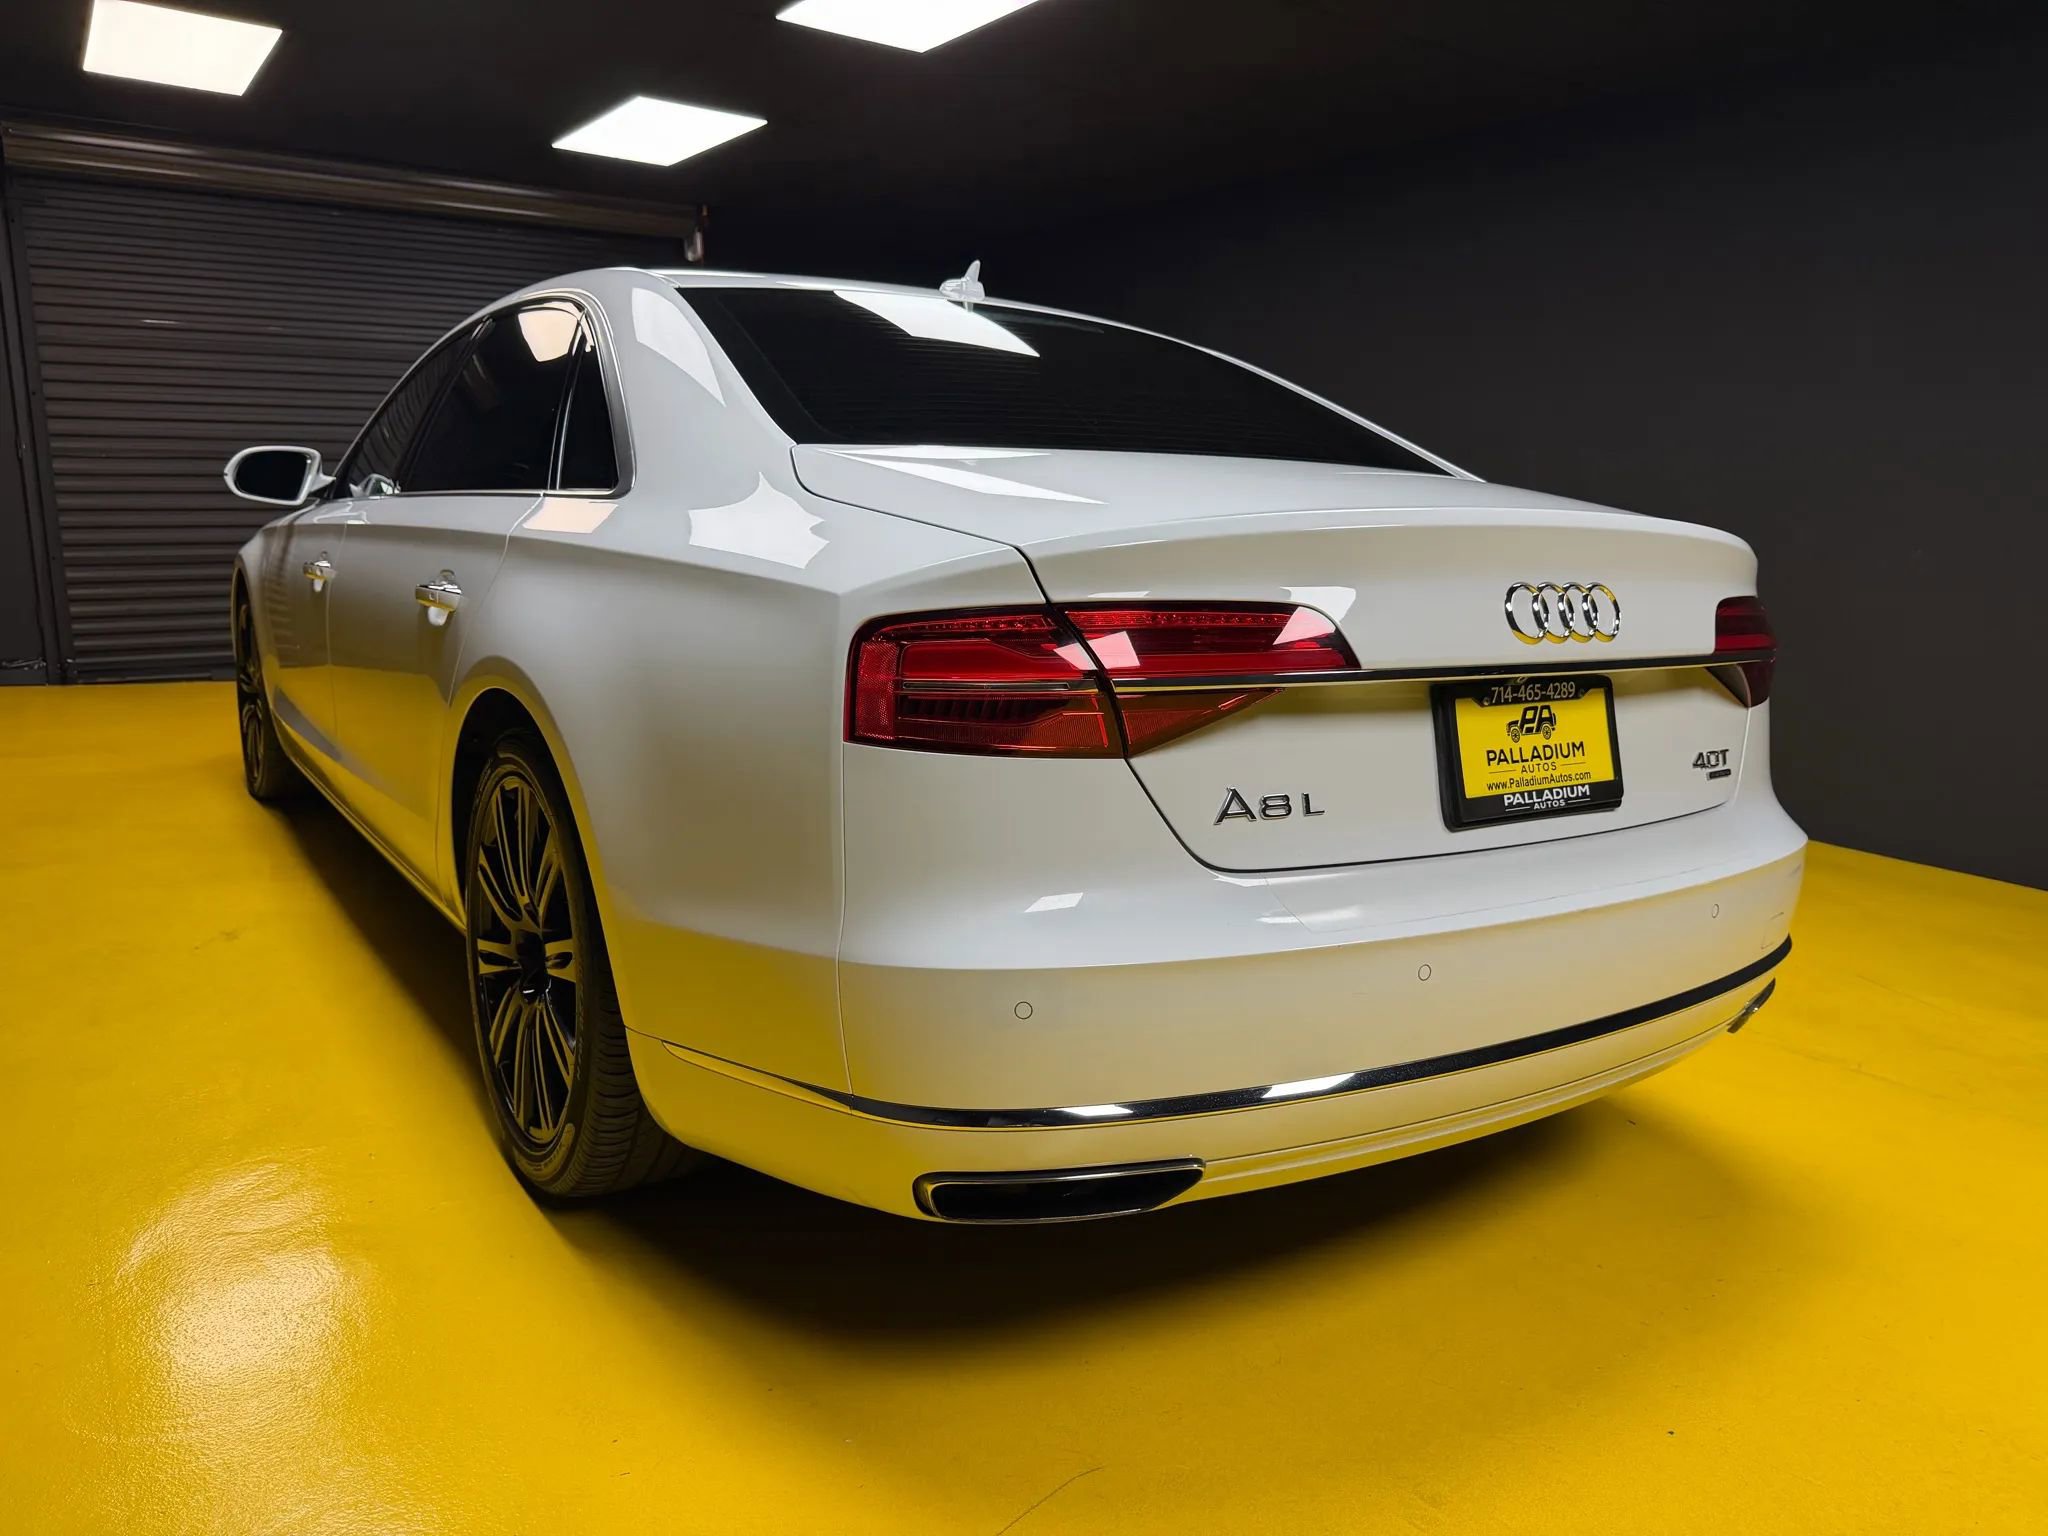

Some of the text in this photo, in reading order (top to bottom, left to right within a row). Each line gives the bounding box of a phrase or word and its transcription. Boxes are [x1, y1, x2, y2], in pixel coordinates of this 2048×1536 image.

[1491, 681, 1576, 704] 714-465-4289
[1486, 741, 1585, 766] PALLADIUM
[1521, 761, 1557, 774] AUTOS
[1486, 771, 1592, 791] www.PalladiumAutos.com
[1503, 784, 1590, 806] PALLADIUM
[1533, 799, 1566, 810] AUTOS
